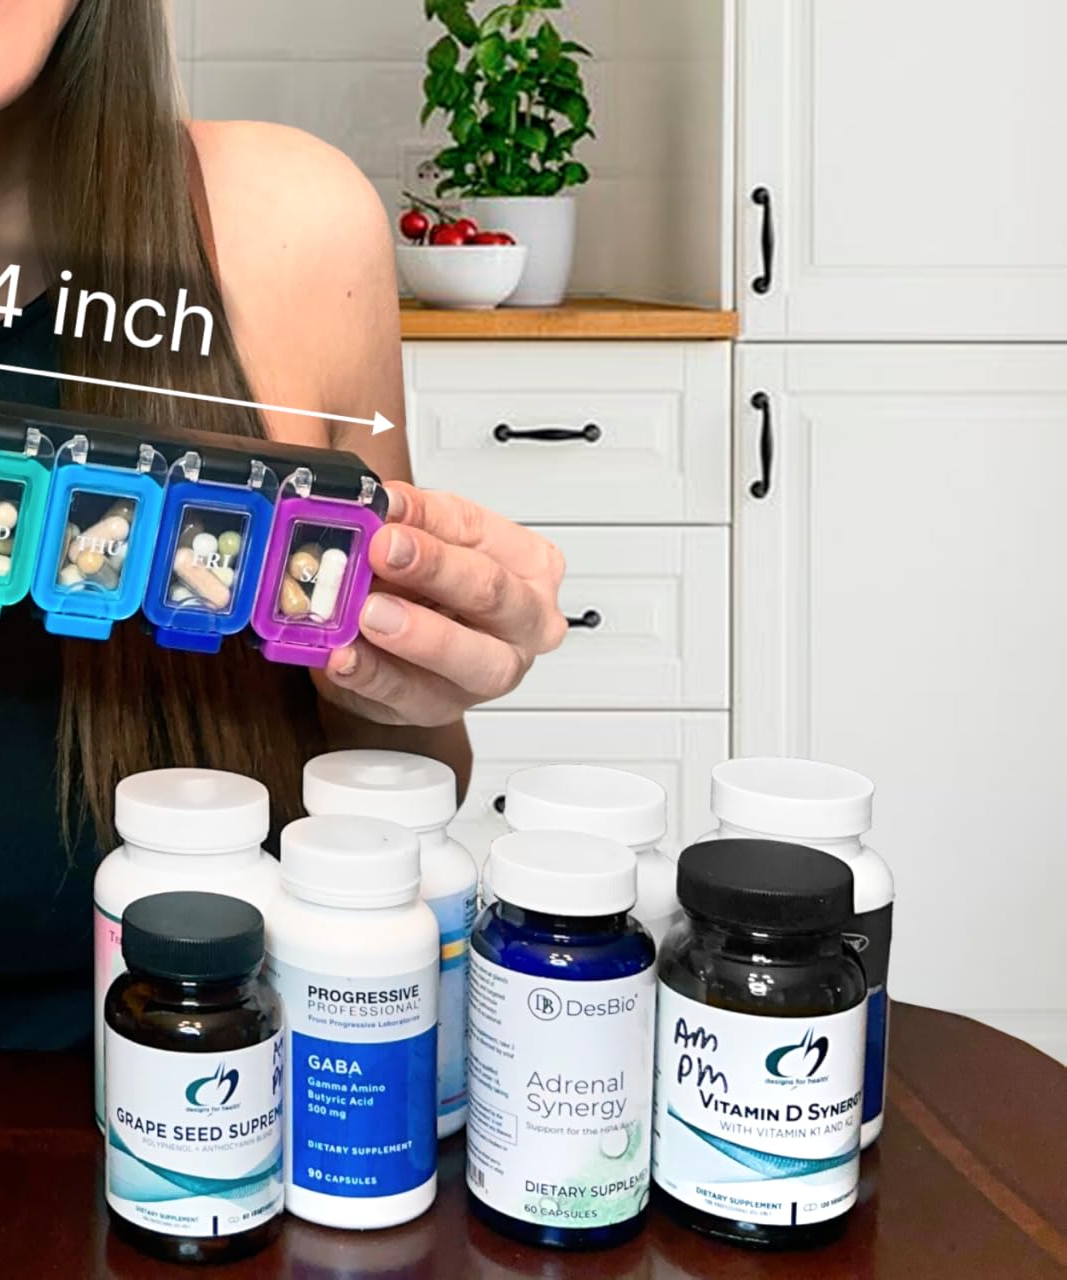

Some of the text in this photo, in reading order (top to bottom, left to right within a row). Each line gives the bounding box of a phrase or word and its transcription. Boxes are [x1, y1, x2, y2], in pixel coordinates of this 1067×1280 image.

[76, 535, 127, 556] THU
[192, 550, 232, 569] FRI
[308, 984, 419, 1004] PROGRESSIVE
[308, 999, 420, 1017] PROFESSIONAL
[308, 1014, 327, 1025] From
[329, 1019, 376, 1029] Progressive
[308, 1054, 363, 1076] GABA
[308, 1076, 386, 1093] Gamma Amino
[526, 1071, 624, 1095] Adrenal
[795, 1077, 806, 1085] for
[308, 1089, 374, 1106] Butyric Acid
[527, 1093, 627, 1120] Synergy
[308, 1103, 346, 1120] 500 mg
[786, 1104, 803, 1122] D
[117, 1107, 167, 1139] GRAPE
[173, 1126, 222, 1141] SEED
[526, 1121, 564, 1135] Support
[566, 1127, 580, 1135] for
[583, 1126, 598, 1135] the
[719, 1120, 752, 1135] WITH
[756, 1125, 807, 1138] VITAMIN
[810, 1126, 821, 1137] K1
[824, 1121, 843, 1135] AND
[308, 1140, 413, 1155] DIETARY SUPPLEMENT
[308, 1167, 377, 1185] 90 CAPSULES
[525, 1180, 587, 1198] DIETARY
[696, 1186, 728, 1202] DIETARY
[729, 1196, 783, 1211] SUPPLEMENT
[524, 1204, 598, 1219] 60 CAPSULES
